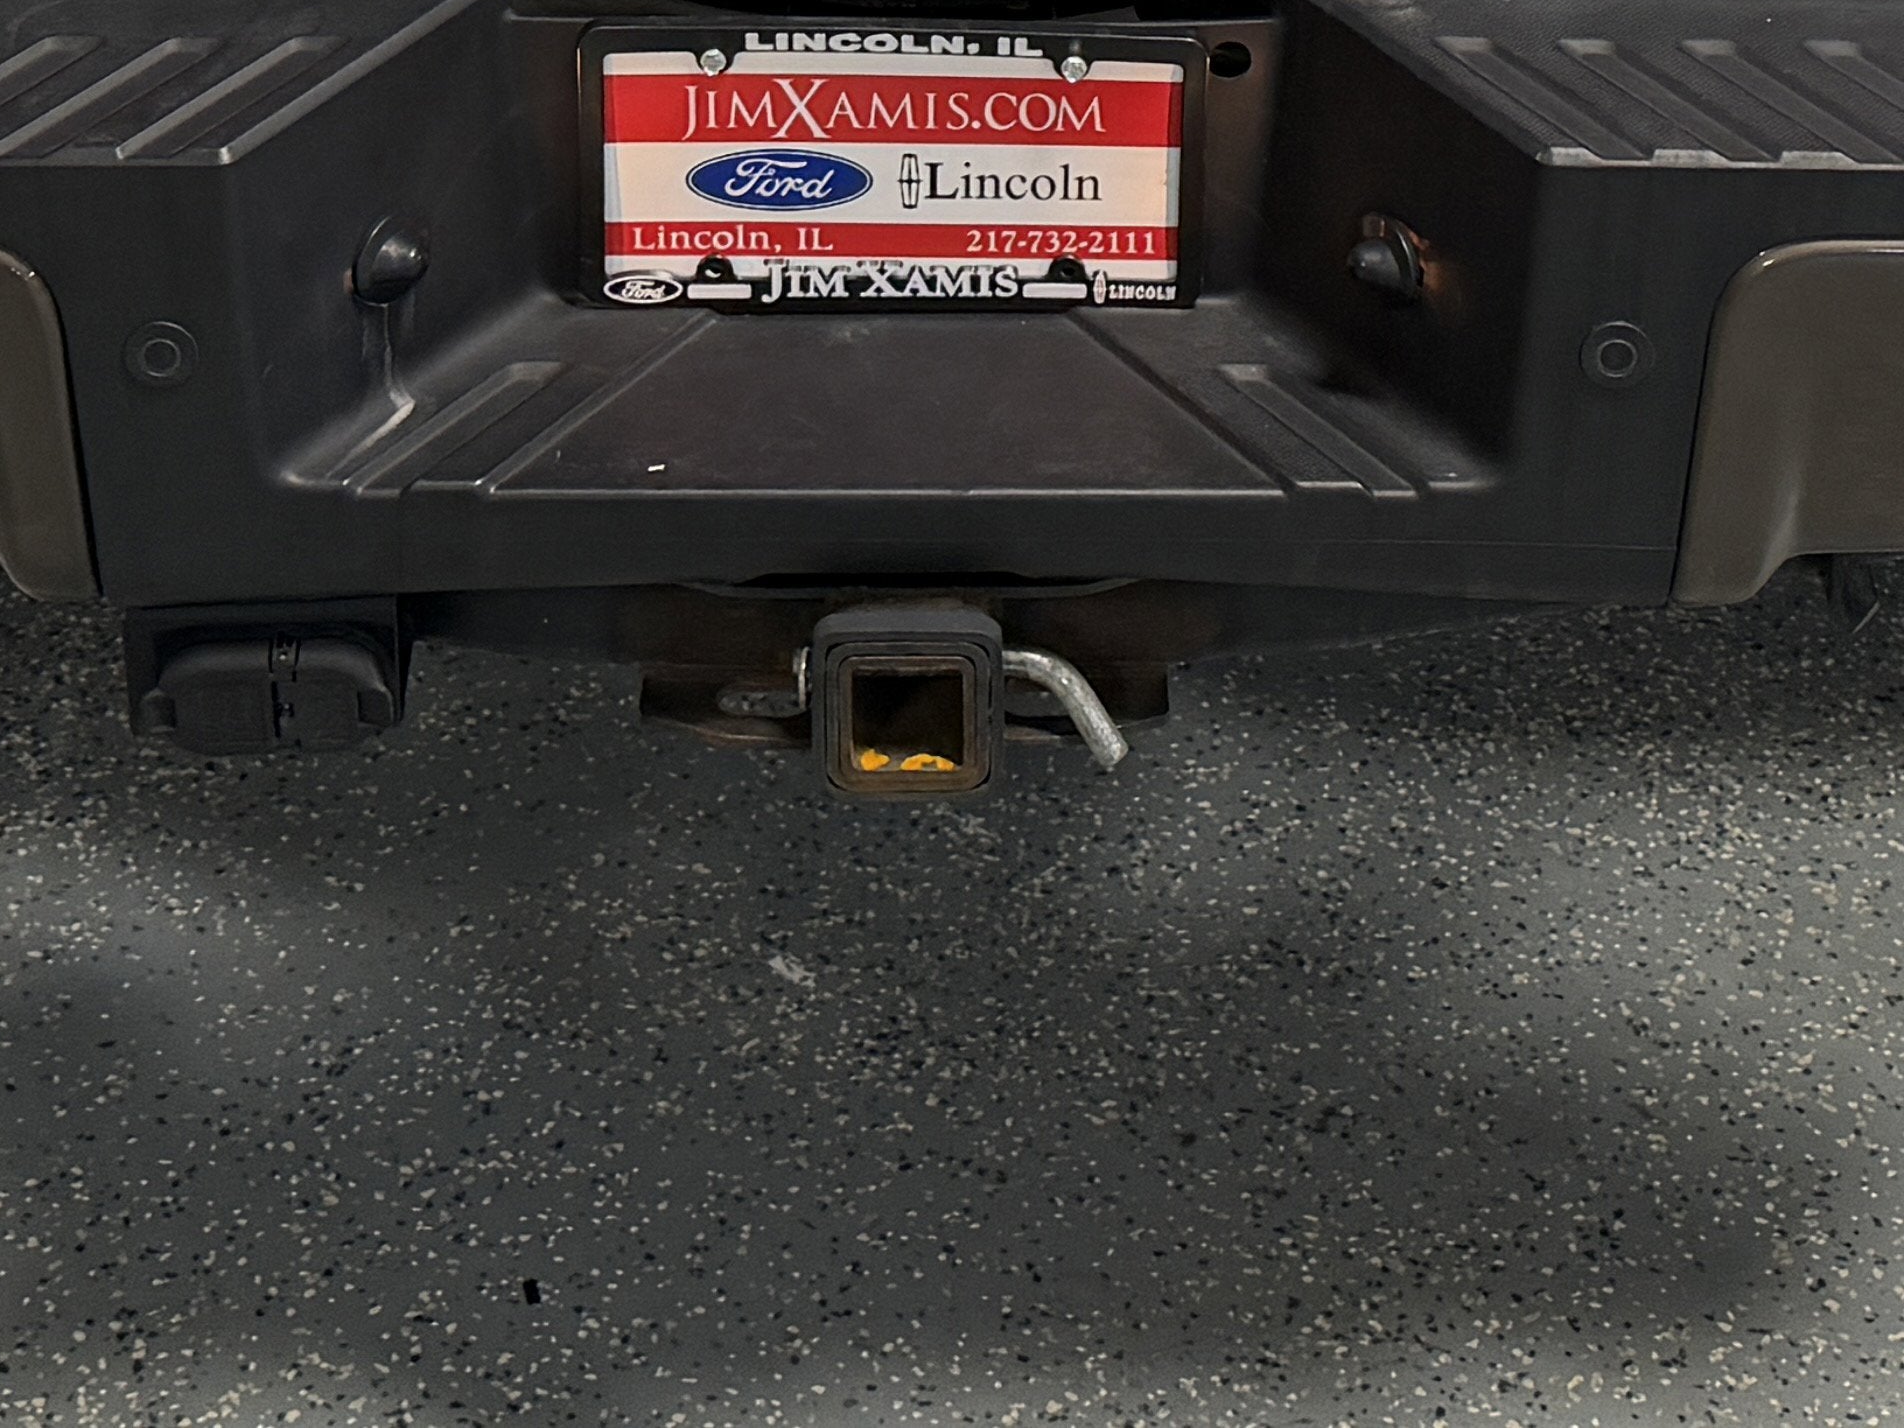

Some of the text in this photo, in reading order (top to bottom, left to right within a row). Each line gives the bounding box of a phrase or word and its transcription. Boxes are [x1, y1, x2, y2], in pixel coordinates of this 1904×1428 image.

[744, 32, 1044, 57] LINCOLN, IL
[681, 78, 1107, 142] JIMXAMIS.COM
[724, 158, 833, 200] Ford
[924, 161, 1103, 202] Lincoln
[632, 225, 834, 254] Lincoln, IL
[966, 229, 1156, 255] 217-732-2111
[620, 279, 667, 301] Ford
[761, 259, 1019, 305] JIM XAMIS
[1108, 283, 1177, 301] LINCOLN
